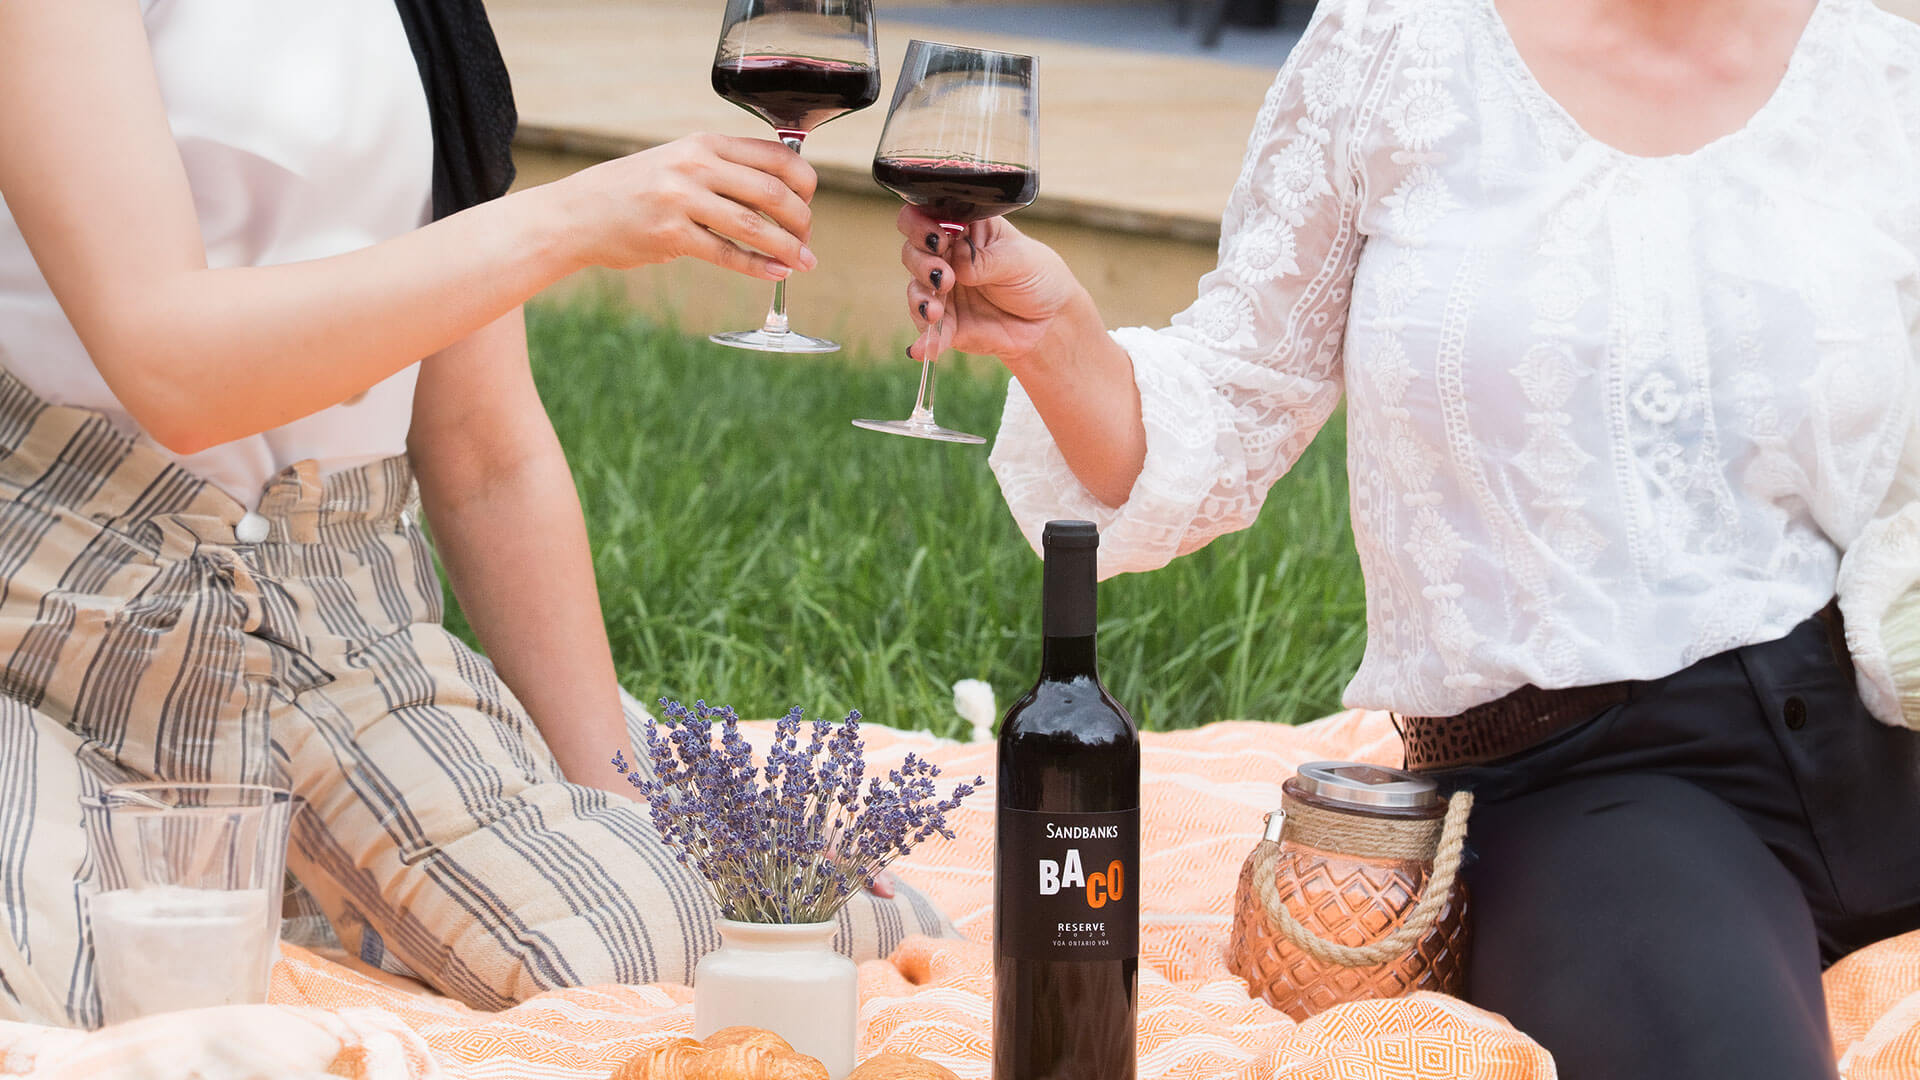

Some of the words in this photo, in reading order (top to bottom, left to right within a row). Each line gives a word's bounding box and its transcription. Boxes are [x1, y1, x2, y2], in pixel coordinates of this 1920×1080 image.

[1046, 822, 1118, 839] SANDBANKS
[1039, 849, 1125, 909] BACO
[1057, 922, 1105, 932] RESERVE
